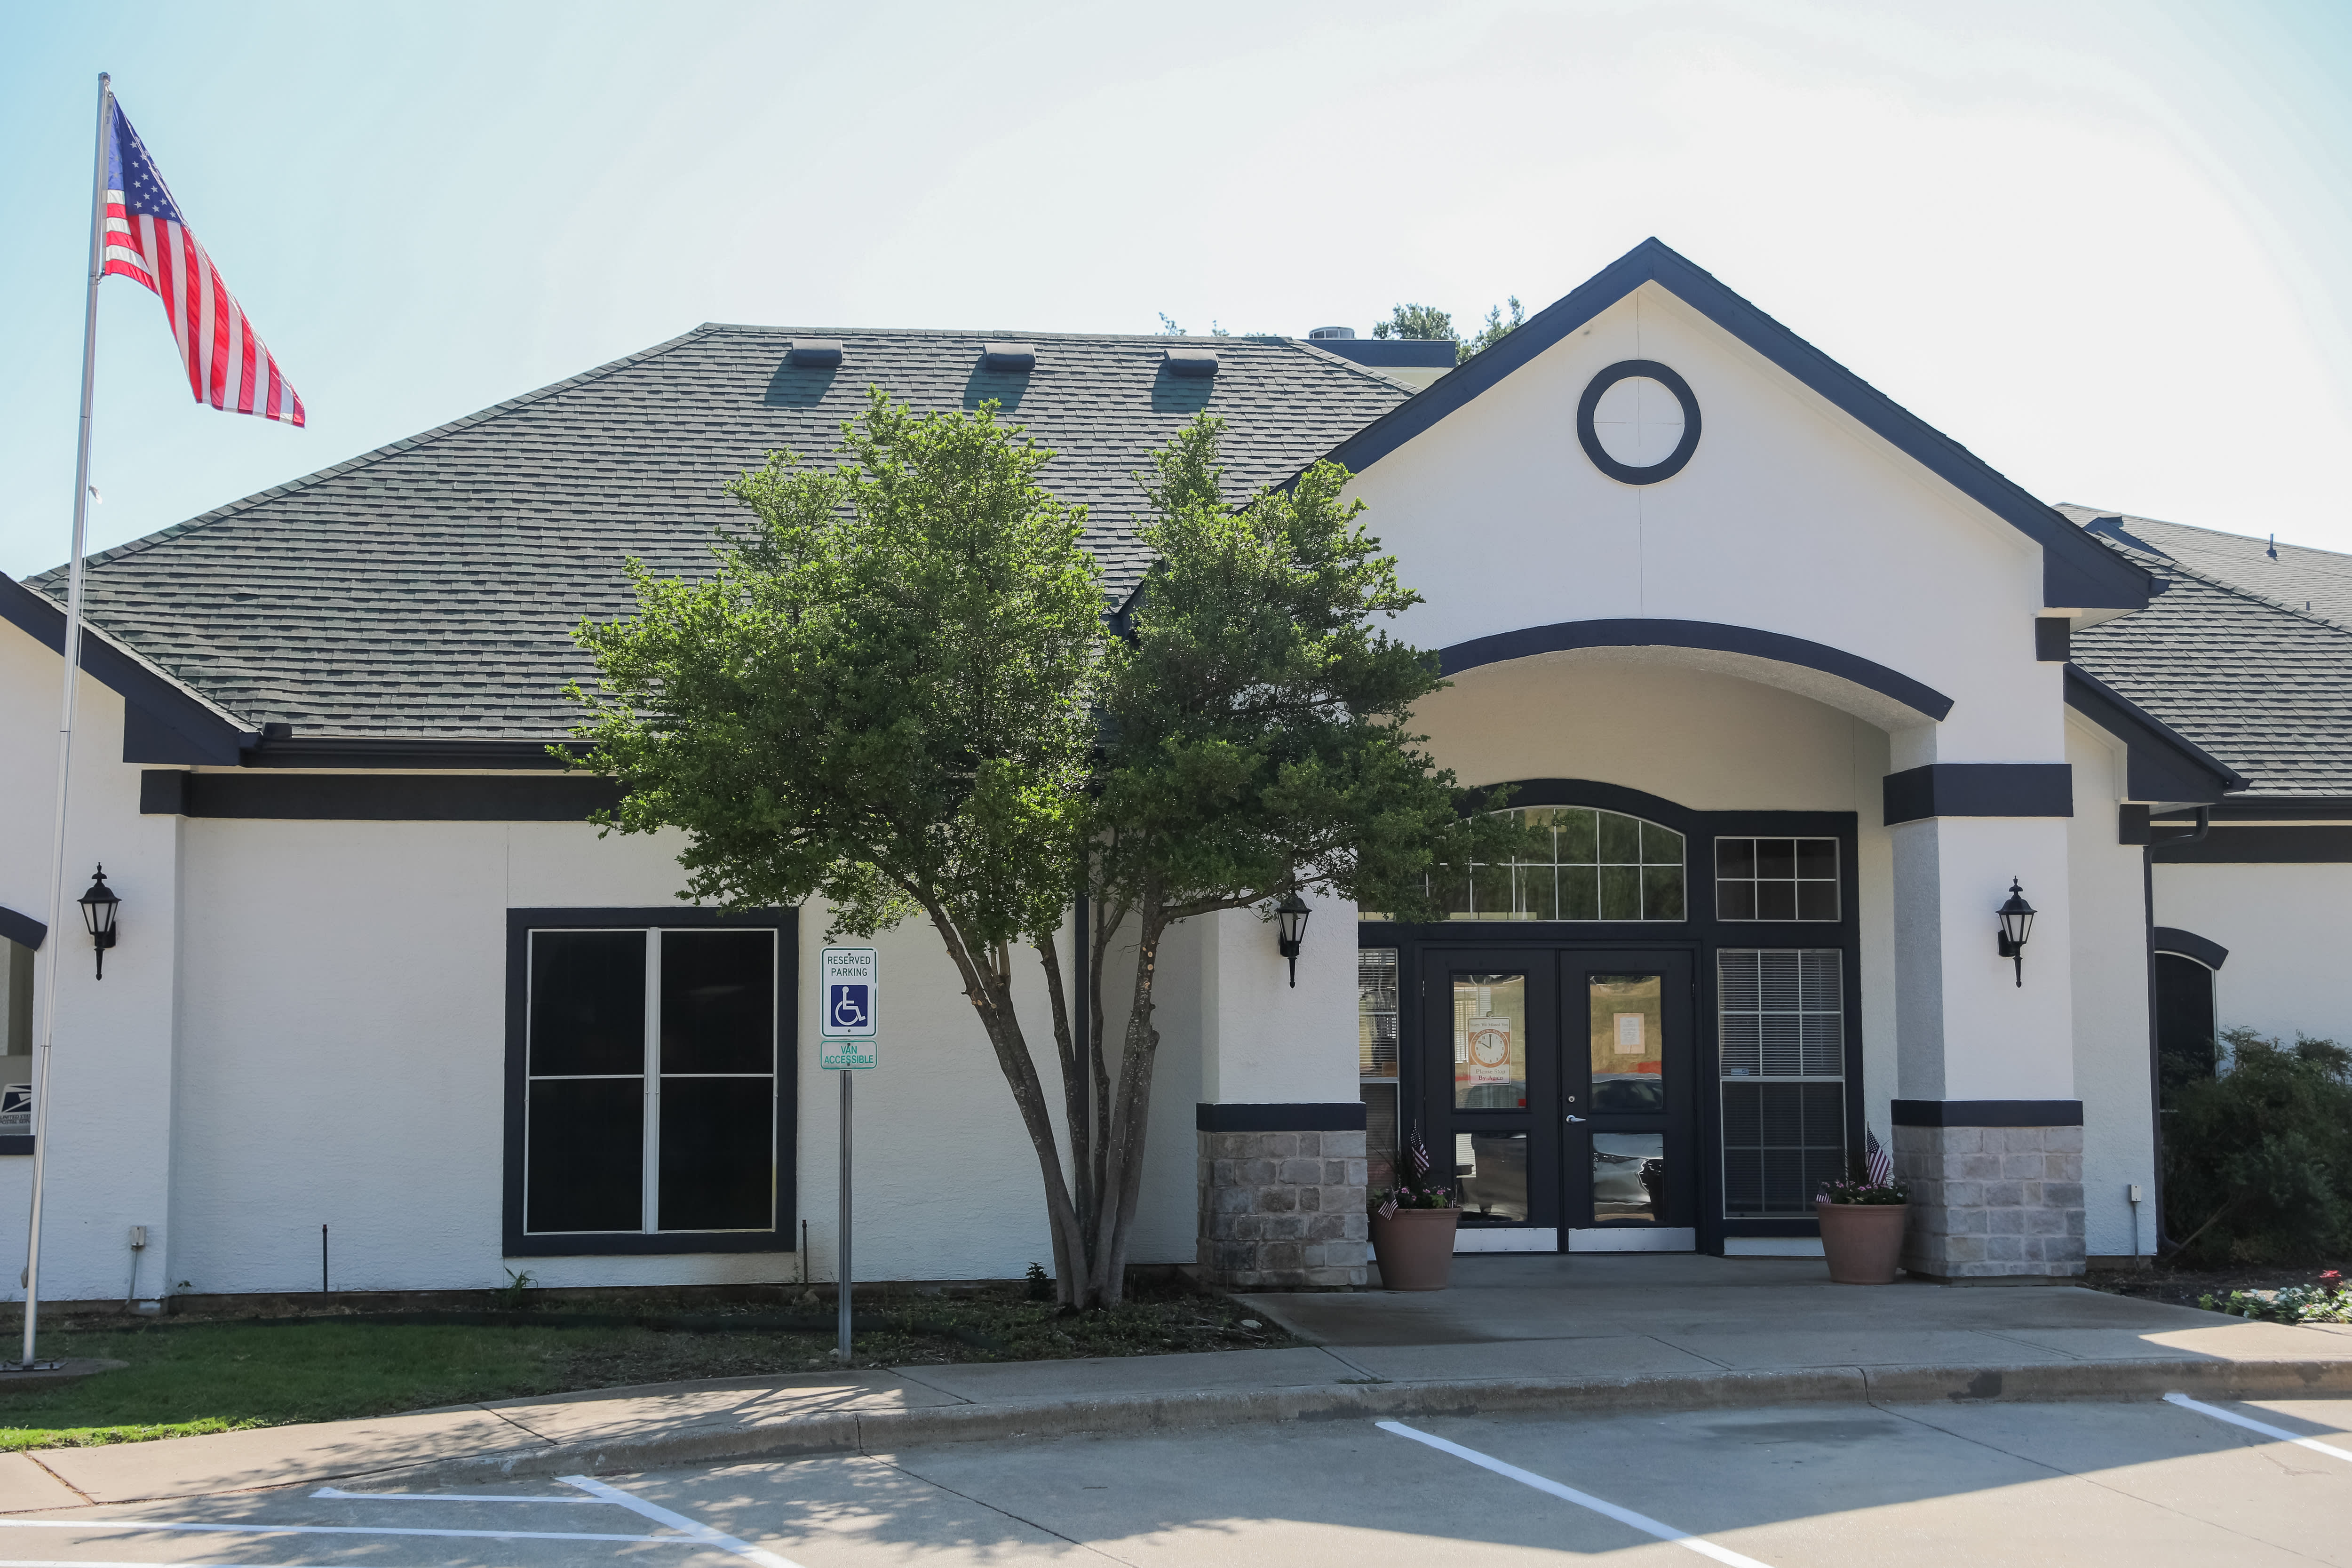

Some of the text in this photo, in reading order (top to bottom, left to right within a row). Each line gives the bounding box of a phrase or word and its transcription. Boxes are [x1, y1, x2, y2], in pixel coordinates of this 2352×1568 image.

[827, 956, 871, 964] RESERVED
[831, 968, 867, 976] PARKING
[824, 1055, 874, 1064] ACCESSIBLE
